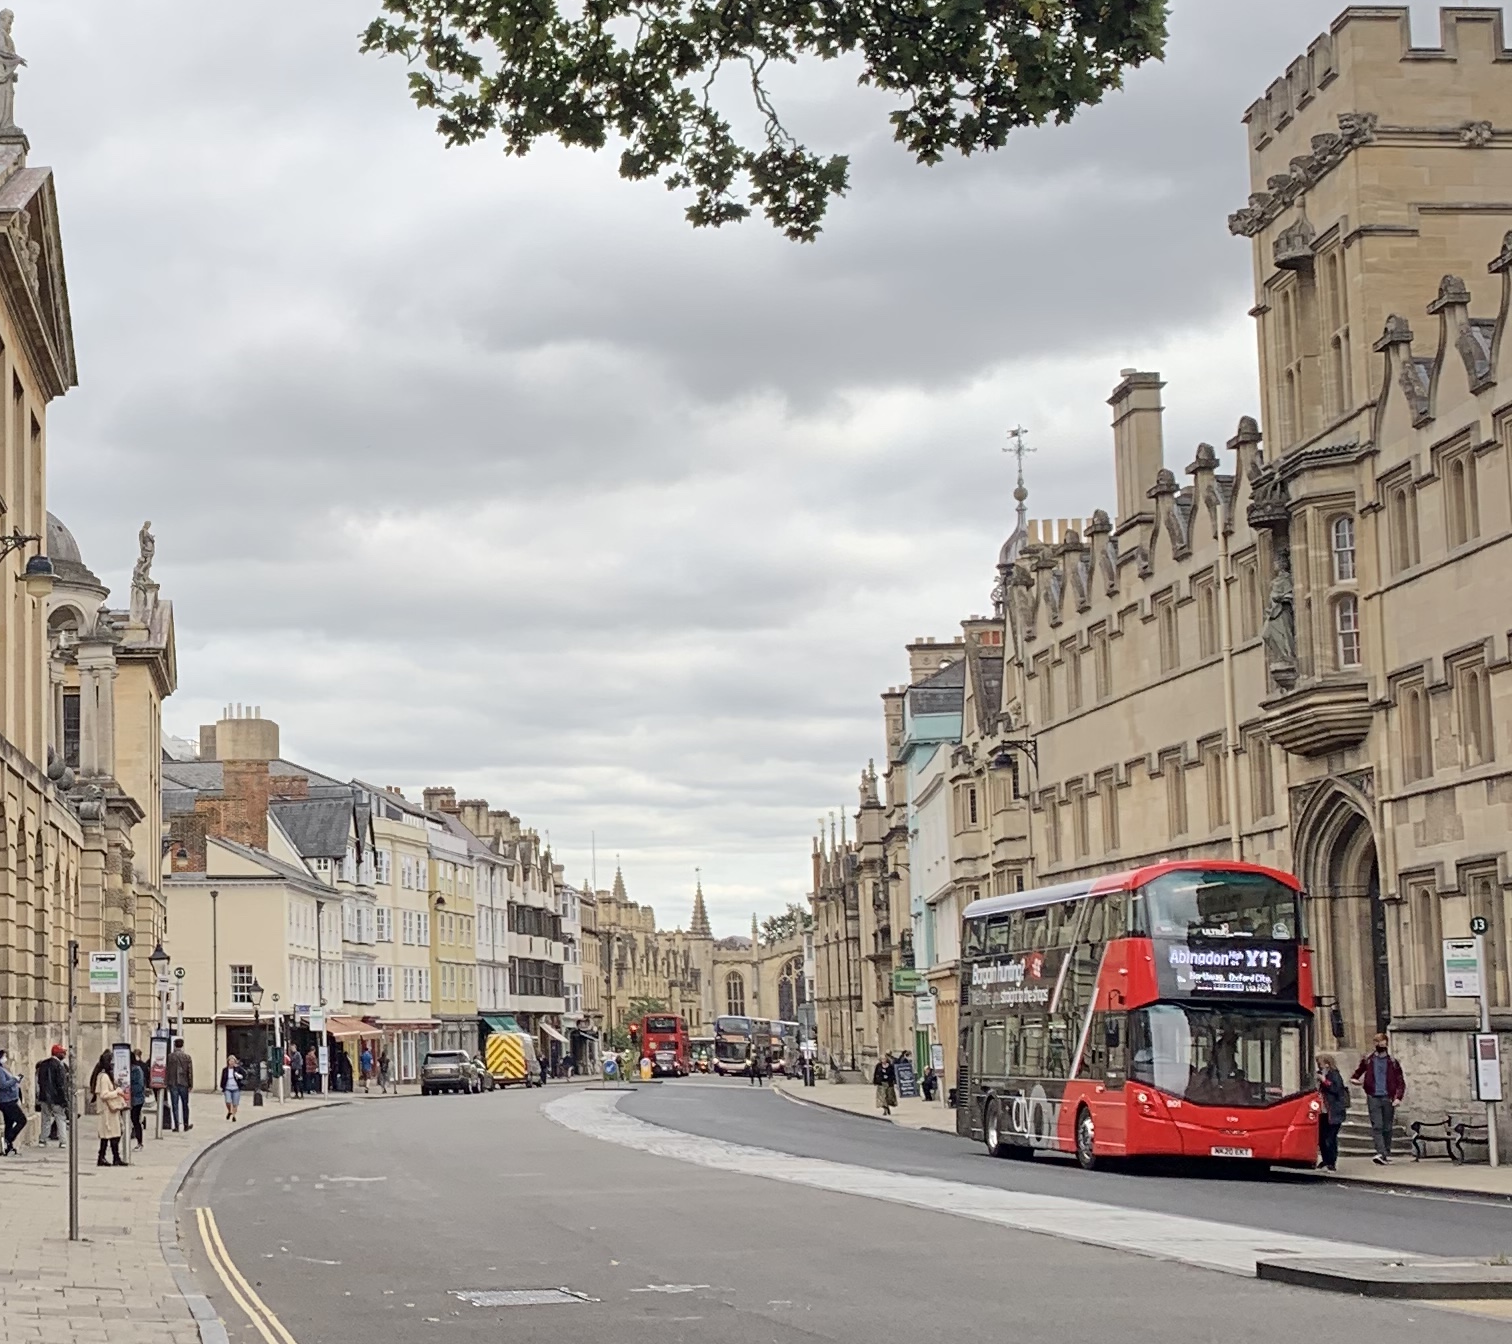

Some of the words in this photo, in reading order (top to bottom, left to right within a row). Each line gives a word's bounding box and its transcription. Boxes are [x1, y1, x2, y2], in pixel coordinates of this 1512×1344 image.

[1472, 919, 1485, 930] J3
[117, 936, 130, 946] K1
[1169, 949, 1229, 966] Abingdon
